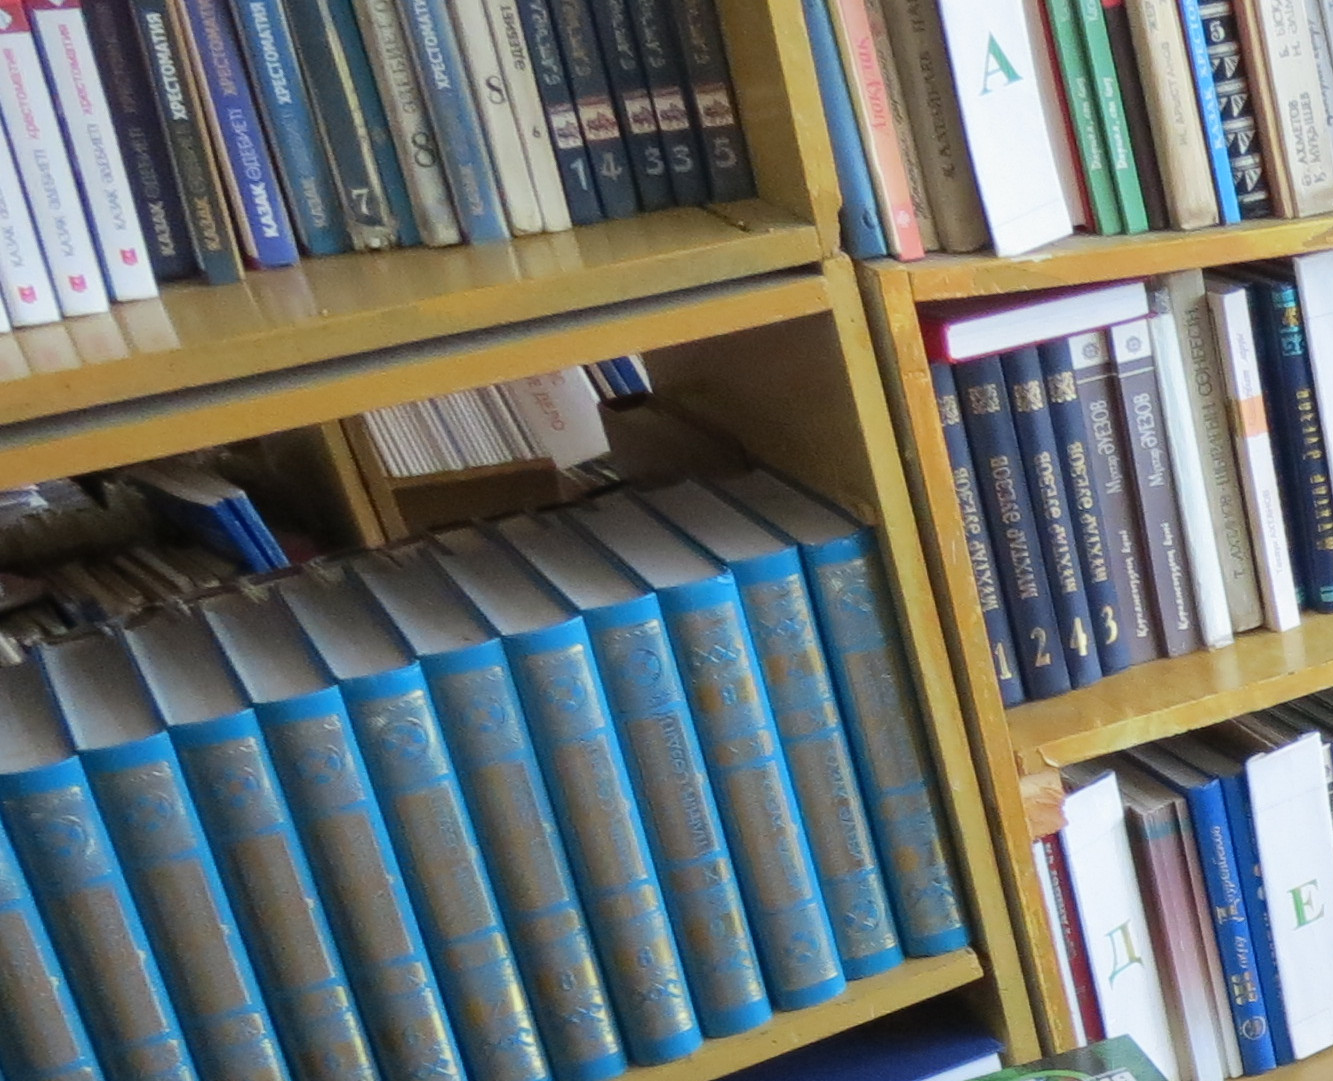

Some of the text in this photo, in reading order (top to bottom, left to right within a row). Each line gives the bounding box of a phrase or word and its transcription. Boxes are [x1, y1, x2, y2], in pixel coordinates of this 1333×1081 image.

[248, 0, 293, 106] ХРЕСТОМАТИЯ
[1209, 20, 1227, 43] 5
[145, 10, 189, 123] ХРЕСТОМАТИЯ
[981, 31, 1022, 96] А
[1087, 397, 1116, 456] ӘУЕЗОВ
[1131, 391, 1158, 449] ӘУЕЗОВ
[1030, 627, 1051, 668] 2
[1069, 616, 1089, 657] 4
[1102, 604, 1119, 645] 3
[994, 641, 1013, 681] 1
[1286, 879, 1324, 932] Е
[1108, 920, 1141, 984] Д
